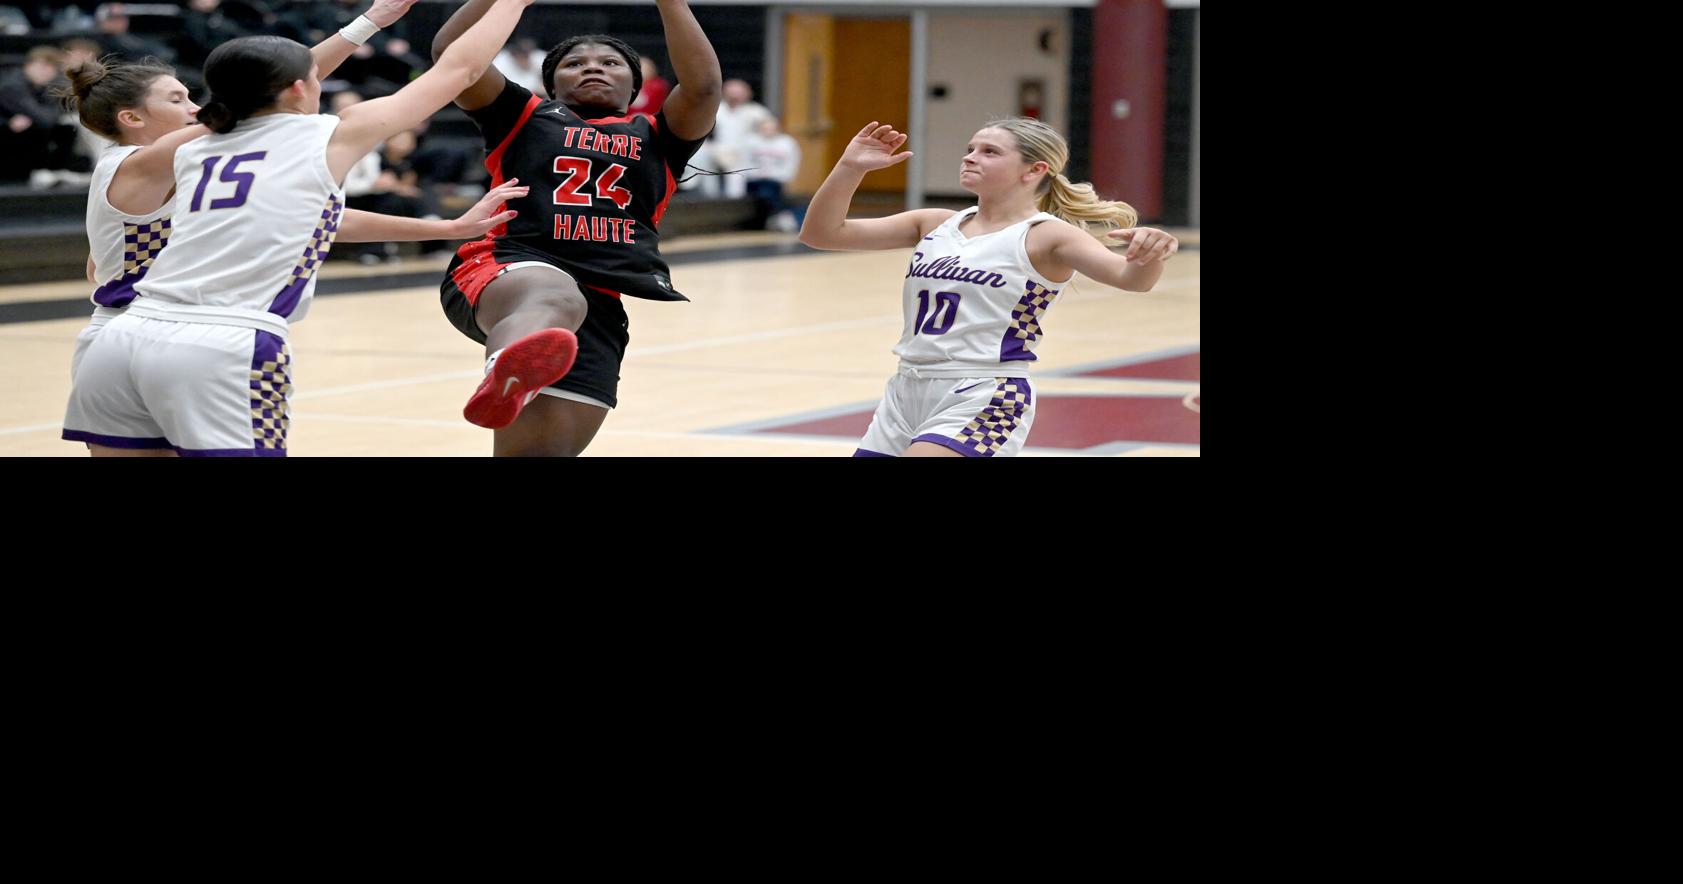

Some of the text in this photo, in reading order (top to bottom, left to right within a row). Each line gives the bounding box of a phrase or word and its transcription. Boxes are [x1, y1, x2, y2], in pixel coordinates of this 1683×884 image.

[563, 126, 642, 160] TERRE
[190, 150, 268, 213] 15
[553, 156, 632, 210] 24
[553, 214, 636, 244] HAUTE
[905, 251, 1007, 288] Sullivan
[914, 289, 962, 336] 10
